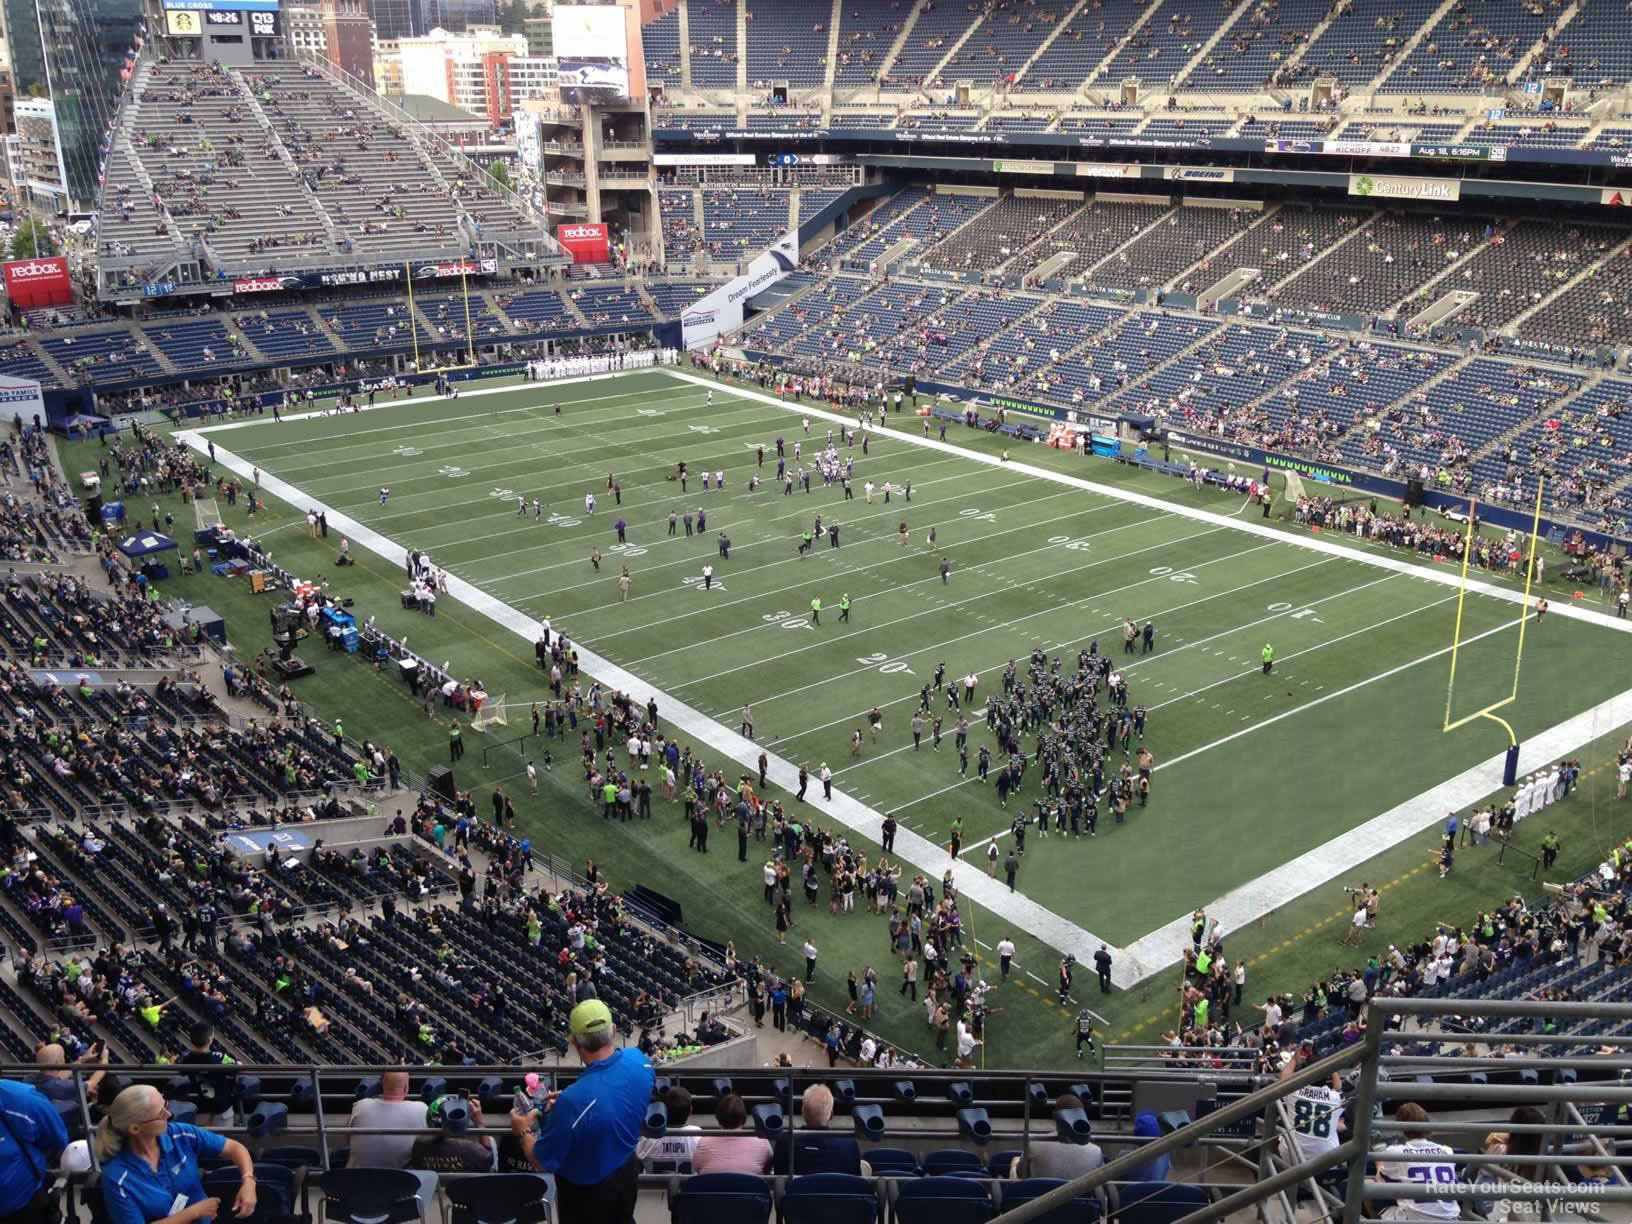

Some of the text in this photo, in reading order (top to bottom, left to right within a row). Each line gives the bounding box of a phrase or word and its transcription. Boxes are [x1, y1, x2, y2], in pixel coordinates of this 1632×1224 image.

[208, 12, 239, 23] 48:26
[251, 12, 275, 24] Q13
[253, 24, 275, 35] FOX
[1087, 167, 1122, 177] verizon
[1184, 170, 1224, 179] BOEING
[1375, 179, 1449, 198] CenturyLink
[728, 267, 777, 303] Dream Fearlessly
[762, 610, 809, 629] 30
[856, 652, 908, 674] 20
[1298, 1088, 1330, 1102] GRAHAM
[1294, 1099, 1333, 1139] 88
[662, 1142, 687, 1153] TATUPU
